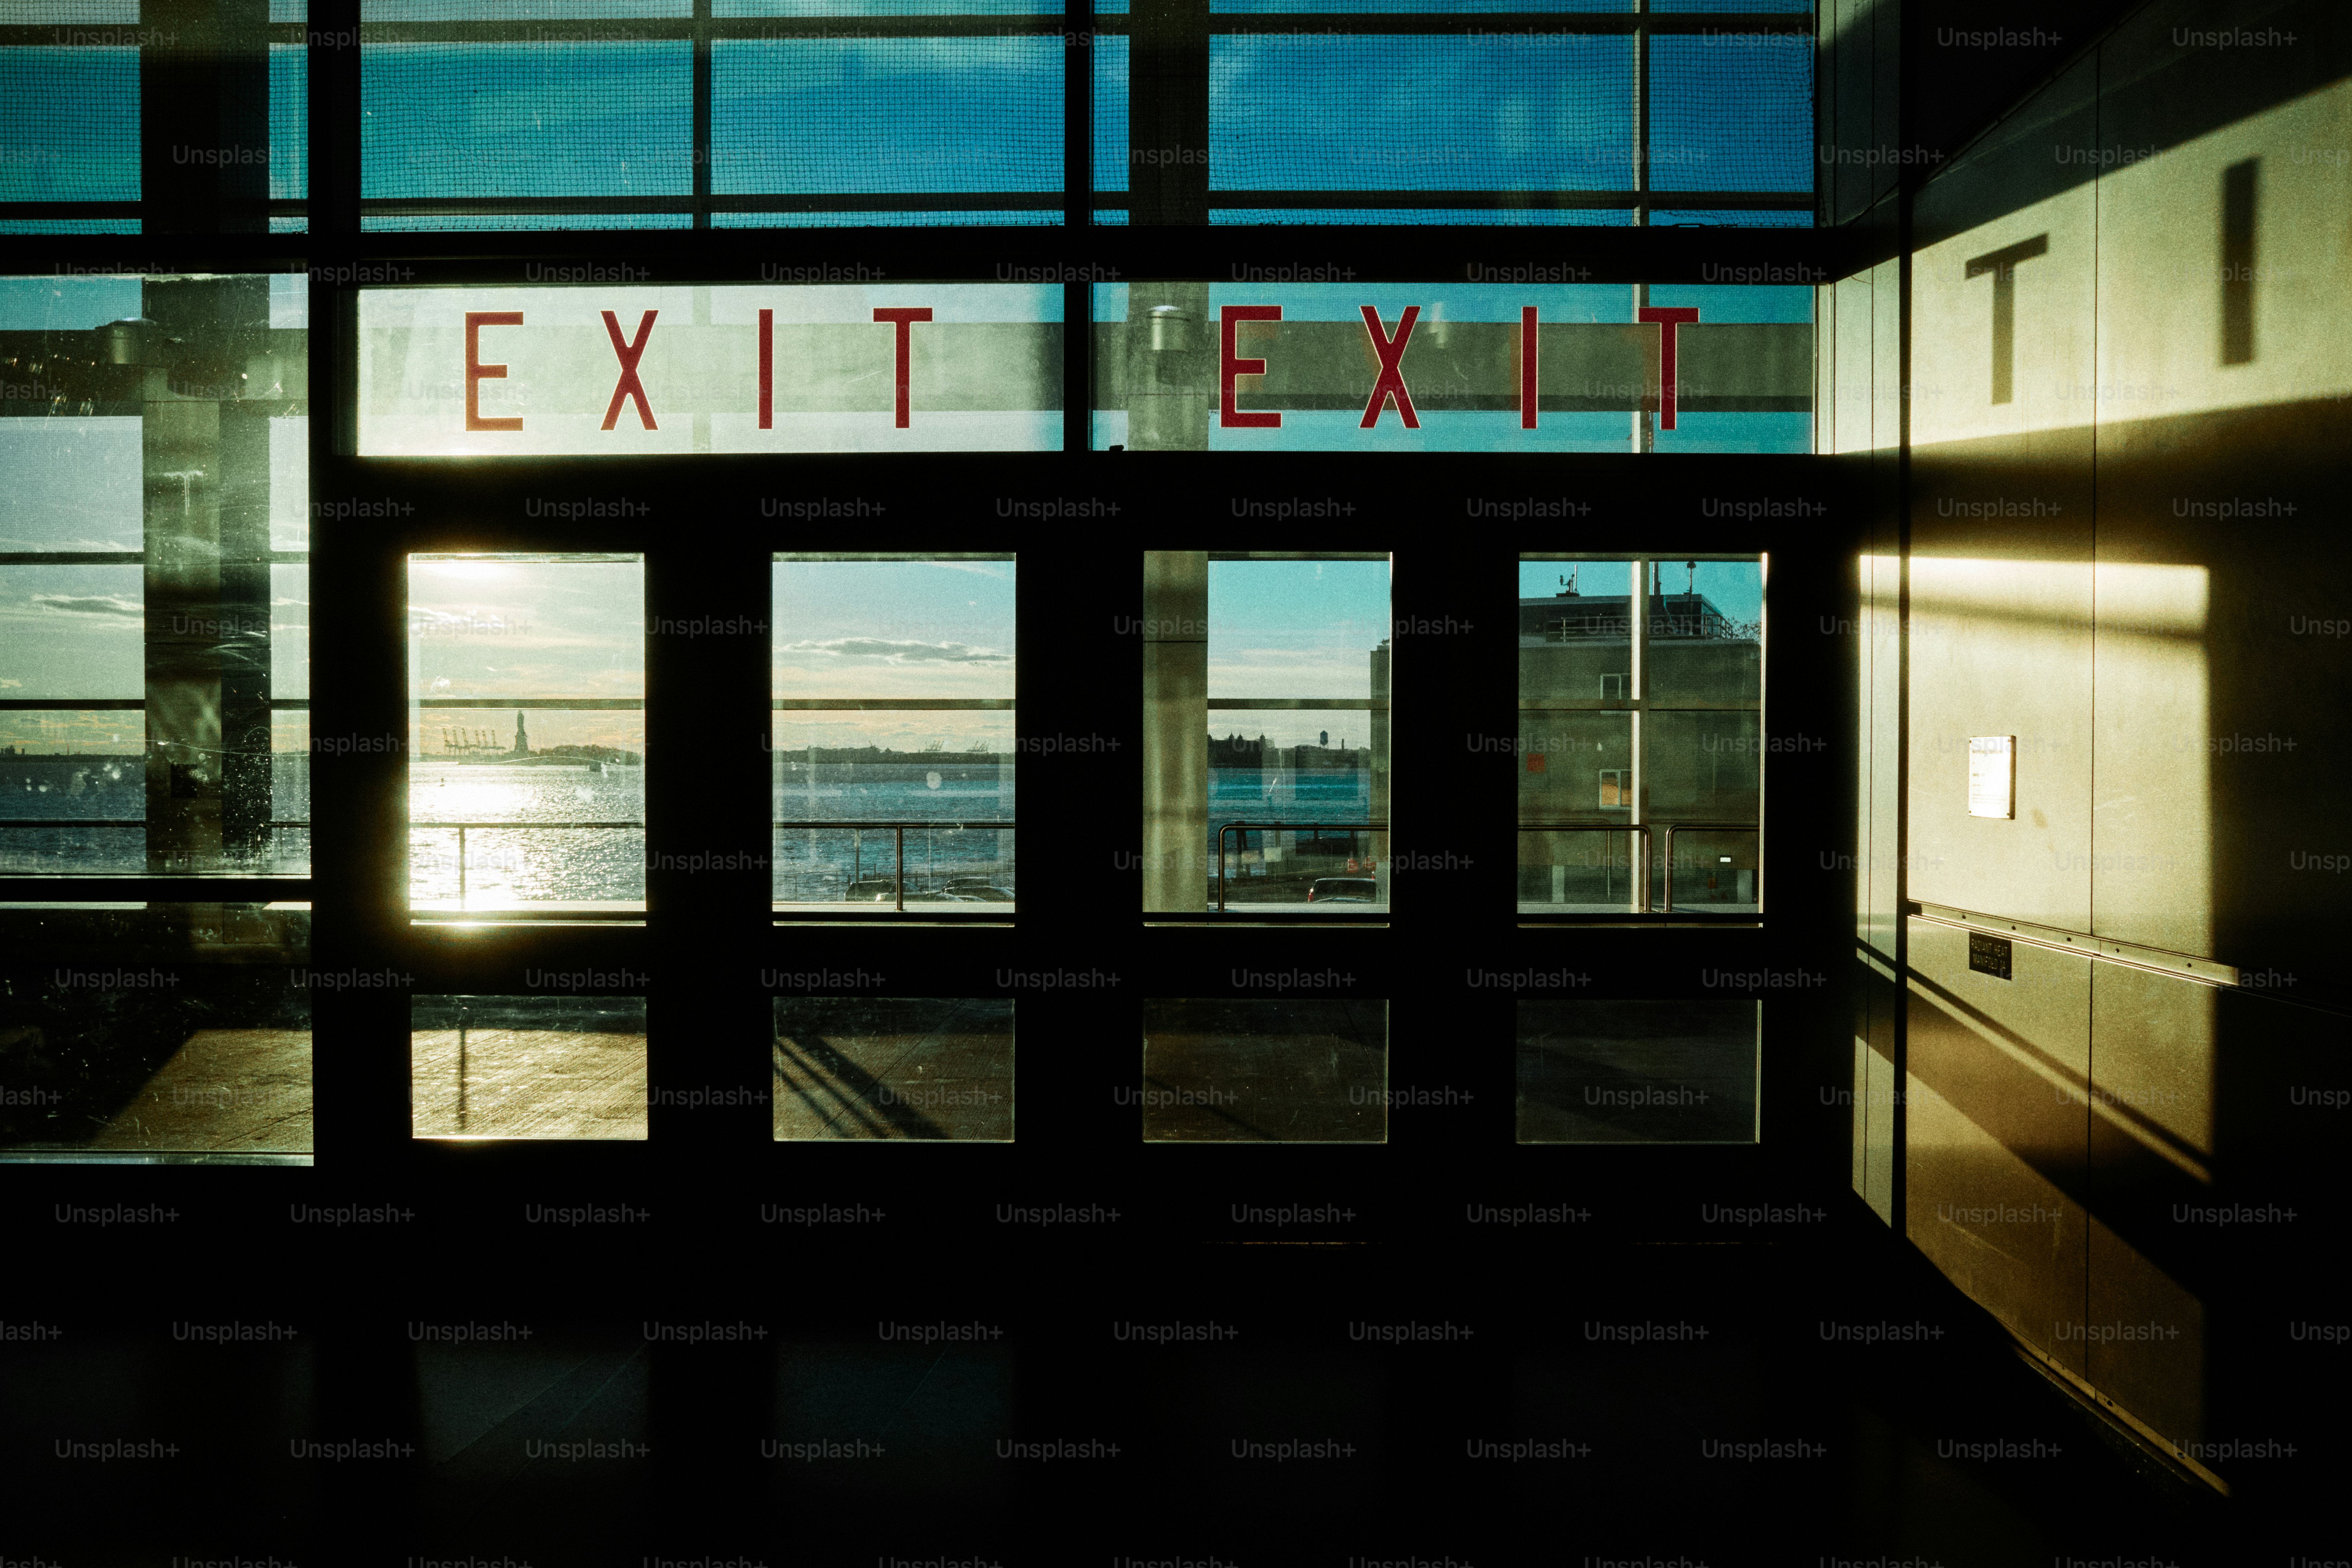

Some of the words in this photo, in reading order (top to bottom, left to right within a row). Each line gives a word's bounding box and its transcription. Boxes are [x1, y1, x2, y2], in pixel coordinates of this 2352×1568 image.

[465, 307, 933, 431] EXIT
[1220, 305, 1700, 430] EXIT
[1994, 944, 2008, 958] HEAT
